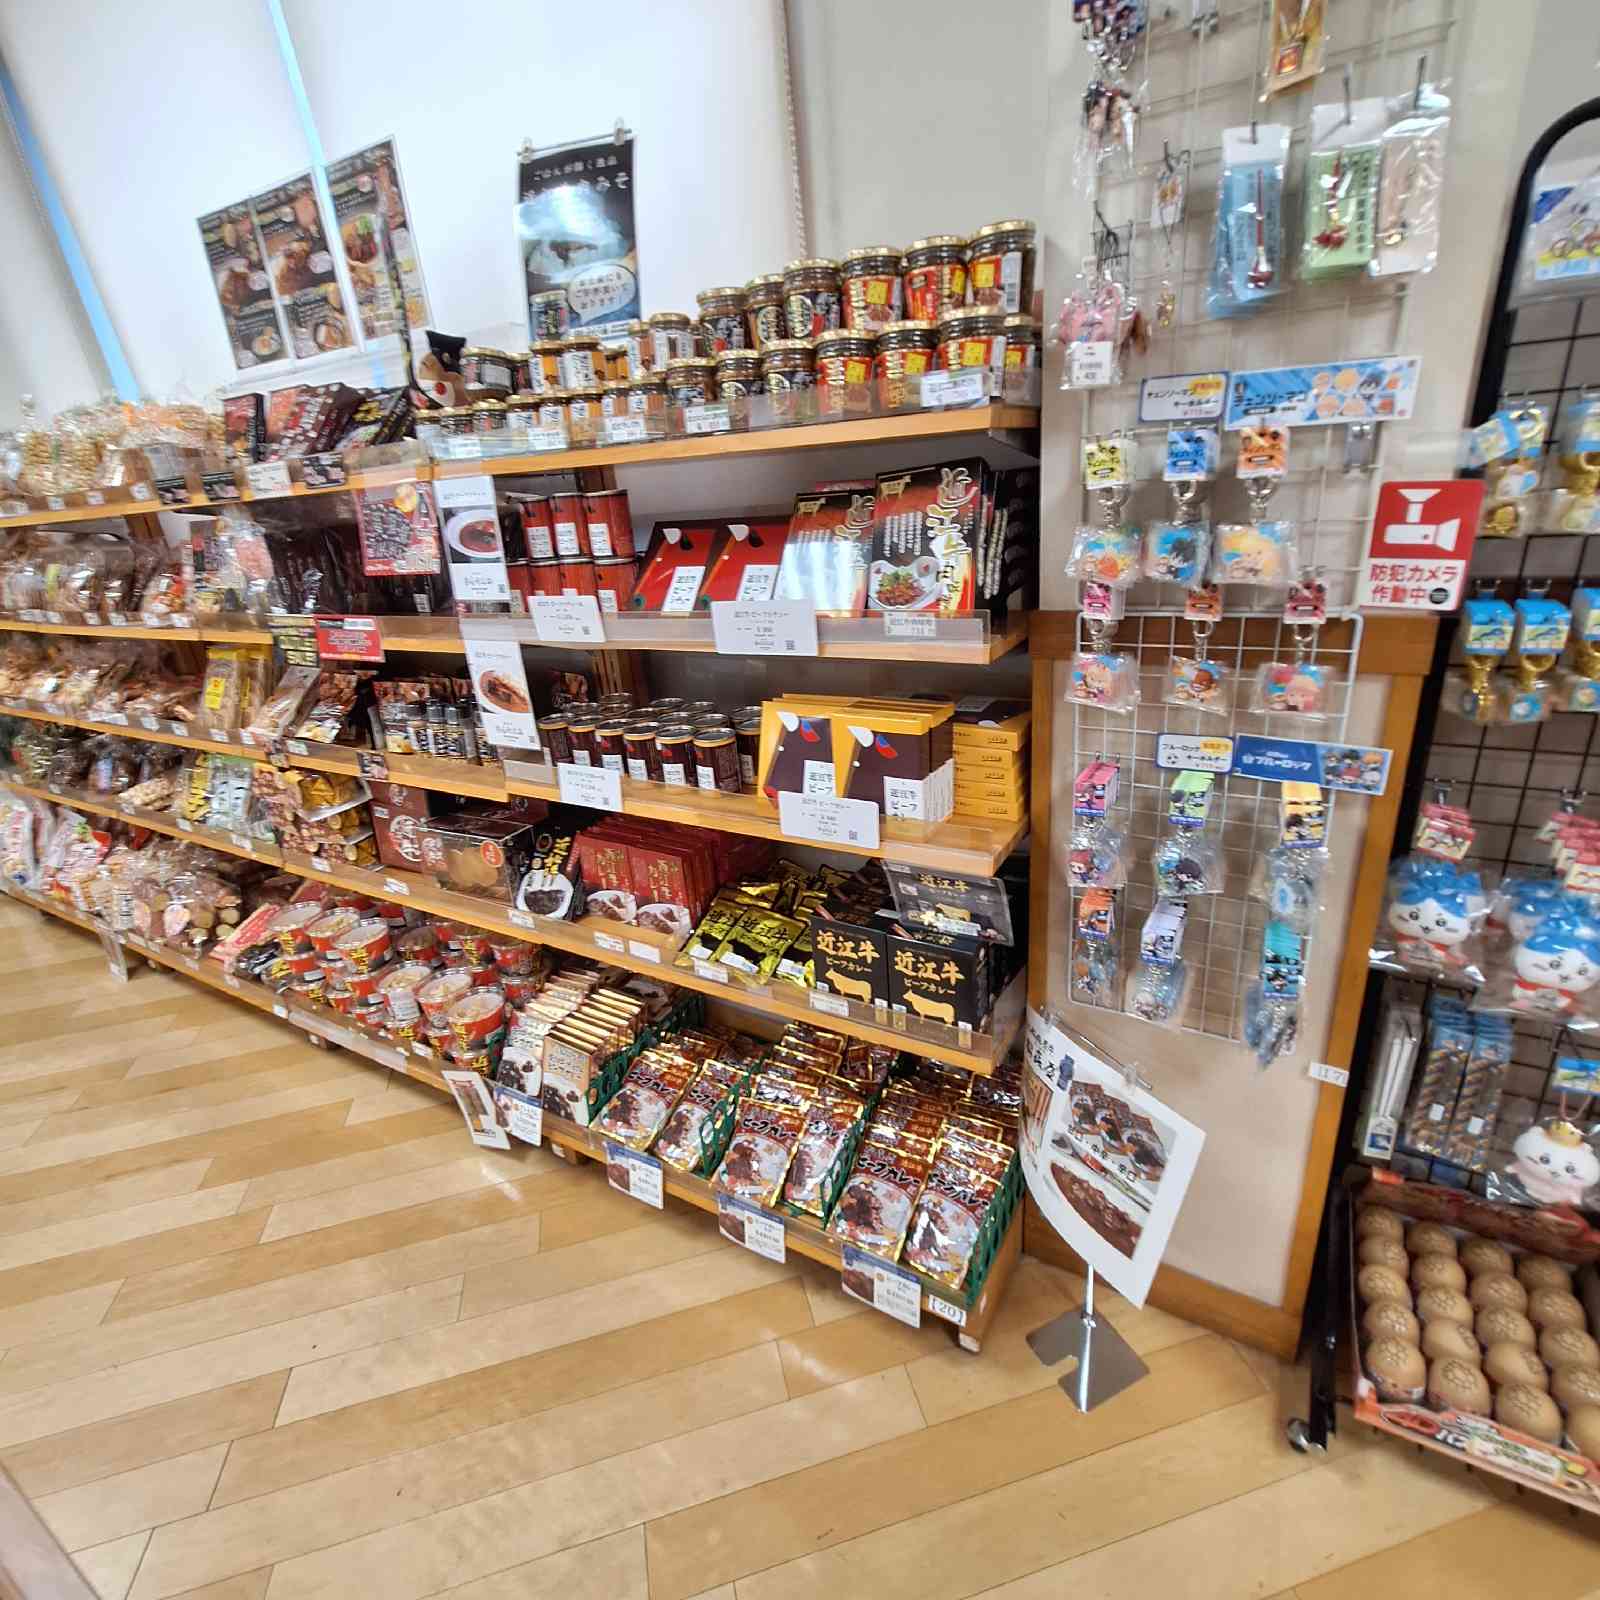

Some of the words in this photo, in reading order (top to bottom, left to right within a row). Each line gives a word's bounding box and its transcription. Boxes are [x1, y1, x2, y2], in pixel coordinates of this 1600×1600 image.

[1369, 564, 1458, 583] 防犯カメラ
[1371, 585, 1427, 604] 作動中
[919, 872, 970, 893] 近江牛
[816, 929, 881, 964] 近江牛
[825, 956, 873, 973] ビーフカレー
[894, 950, 966, 986] 近江牛
[904, 978, 957, 995] ビーフカレー
[742, 1118, 798, 1138] ビーフカレー
[856, 1156, 921, 1185] ビーフカレー
